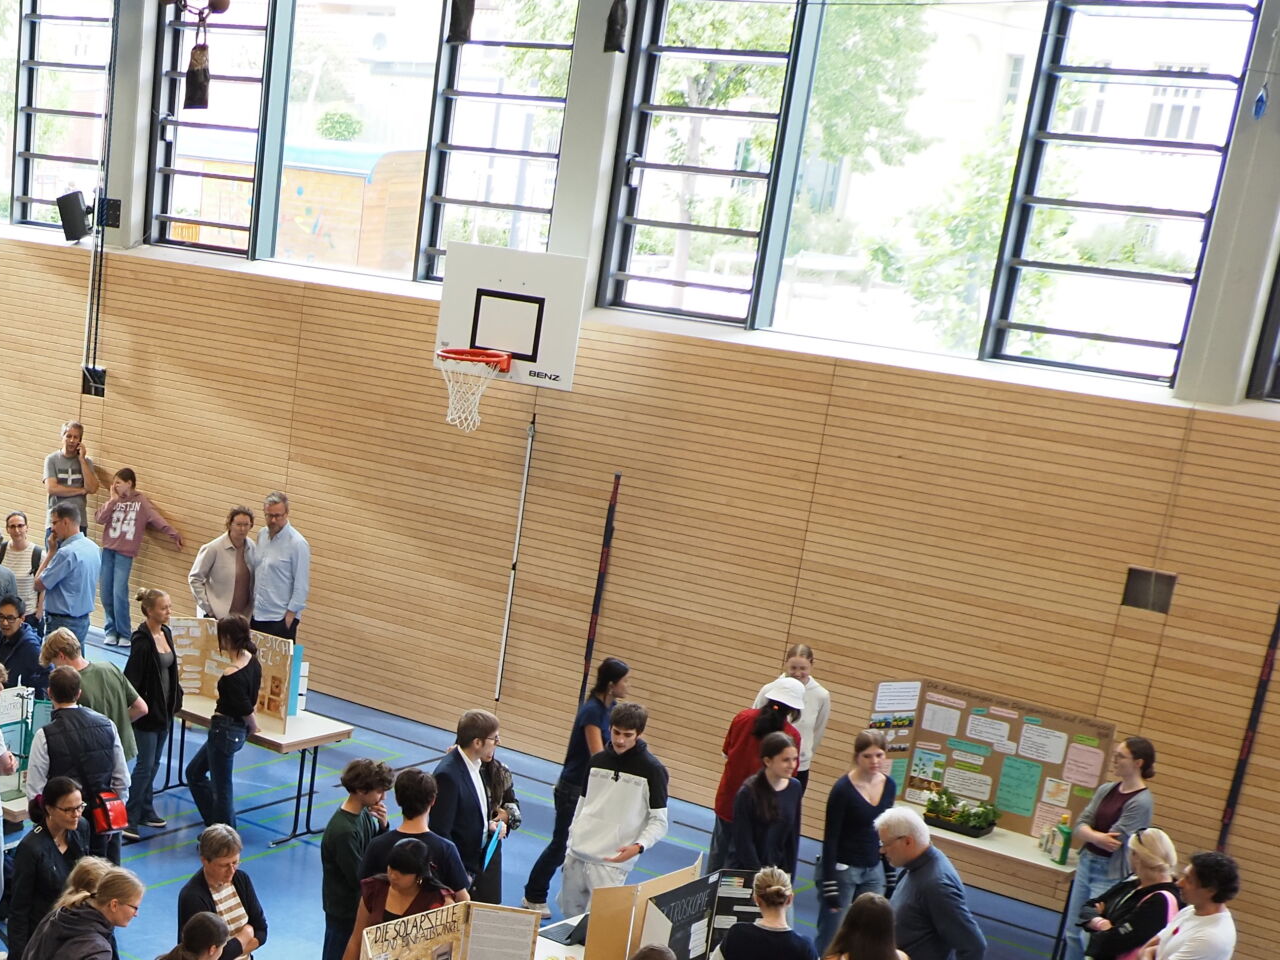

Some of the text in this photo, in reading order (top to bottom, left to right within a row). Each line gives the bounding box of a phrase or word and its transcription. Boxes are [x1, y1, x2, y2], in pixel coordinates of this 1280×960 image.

[528, 369, 560, 381] BENZ
[374, 904, 459, 944] DIE SOLARZELLE
